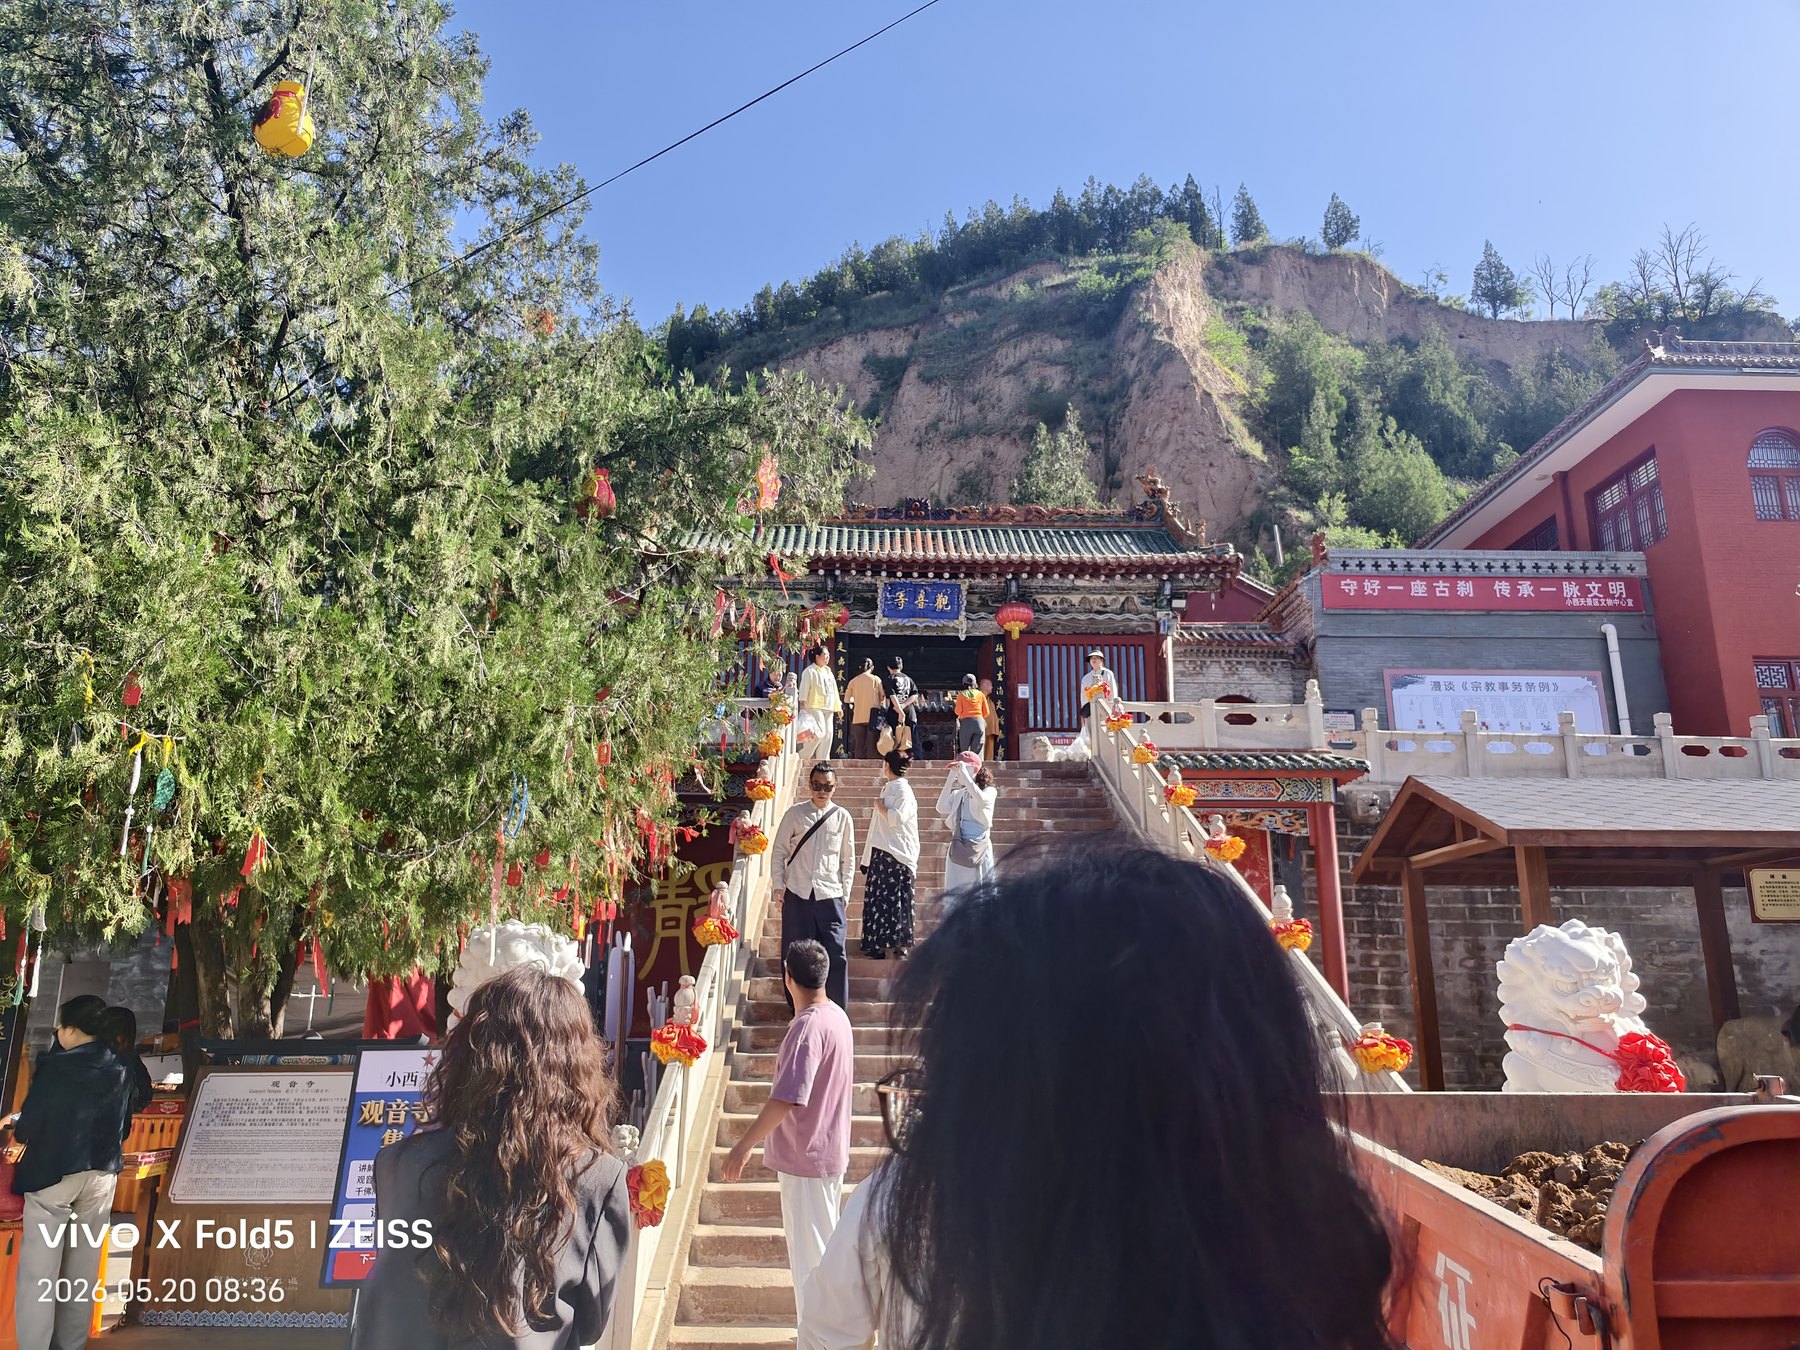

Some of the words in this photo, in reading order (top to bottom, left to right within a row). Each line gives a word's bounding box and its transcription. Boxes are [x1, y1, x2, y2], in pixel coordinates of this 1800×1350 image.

[1340, 579, 1474, 598] 守好一座古刹
[1493, 580, 1627, 598] 传承一脉文明
[1429, 680, 1560, 692] 漫谈《宗教事务条例》
[270, 1080, 316, 1088] 观音寺
[385, 1071, 428, 1088] 小西
